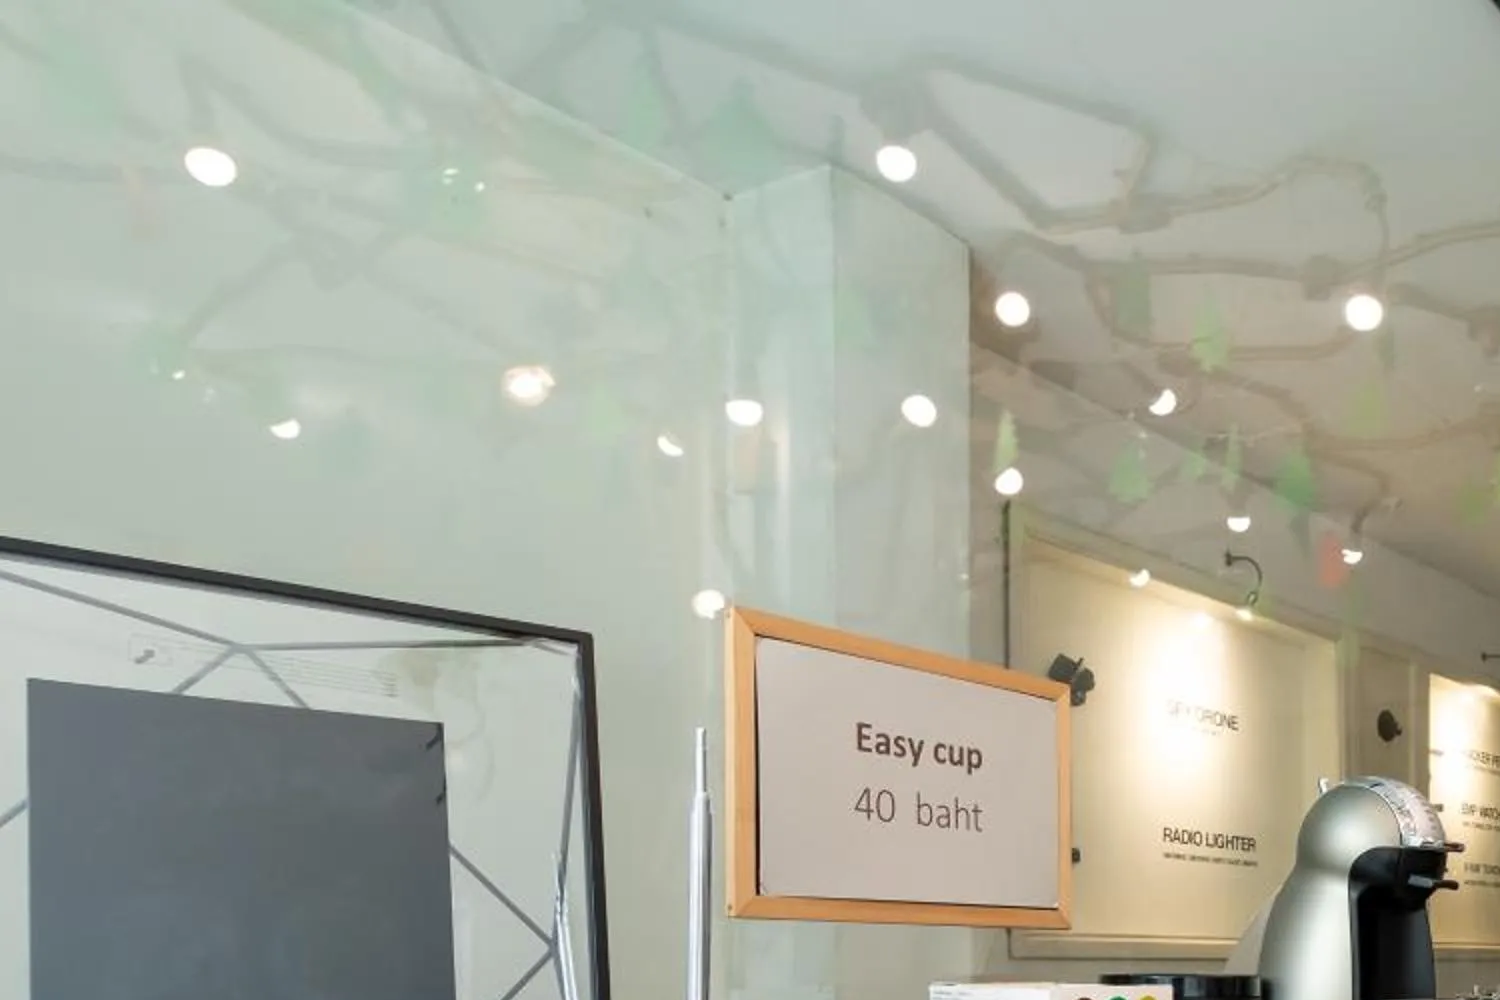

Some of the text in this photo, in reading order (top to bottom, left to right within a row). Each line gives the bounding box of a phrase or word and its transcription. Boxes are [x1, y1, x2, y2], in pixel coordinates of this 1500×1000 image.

[856, 721, 983, 775] Easy cup
[854, 787, 983, 833] 40 baht
[1163, 827, 1257, 852] RADIO LIGHTER
